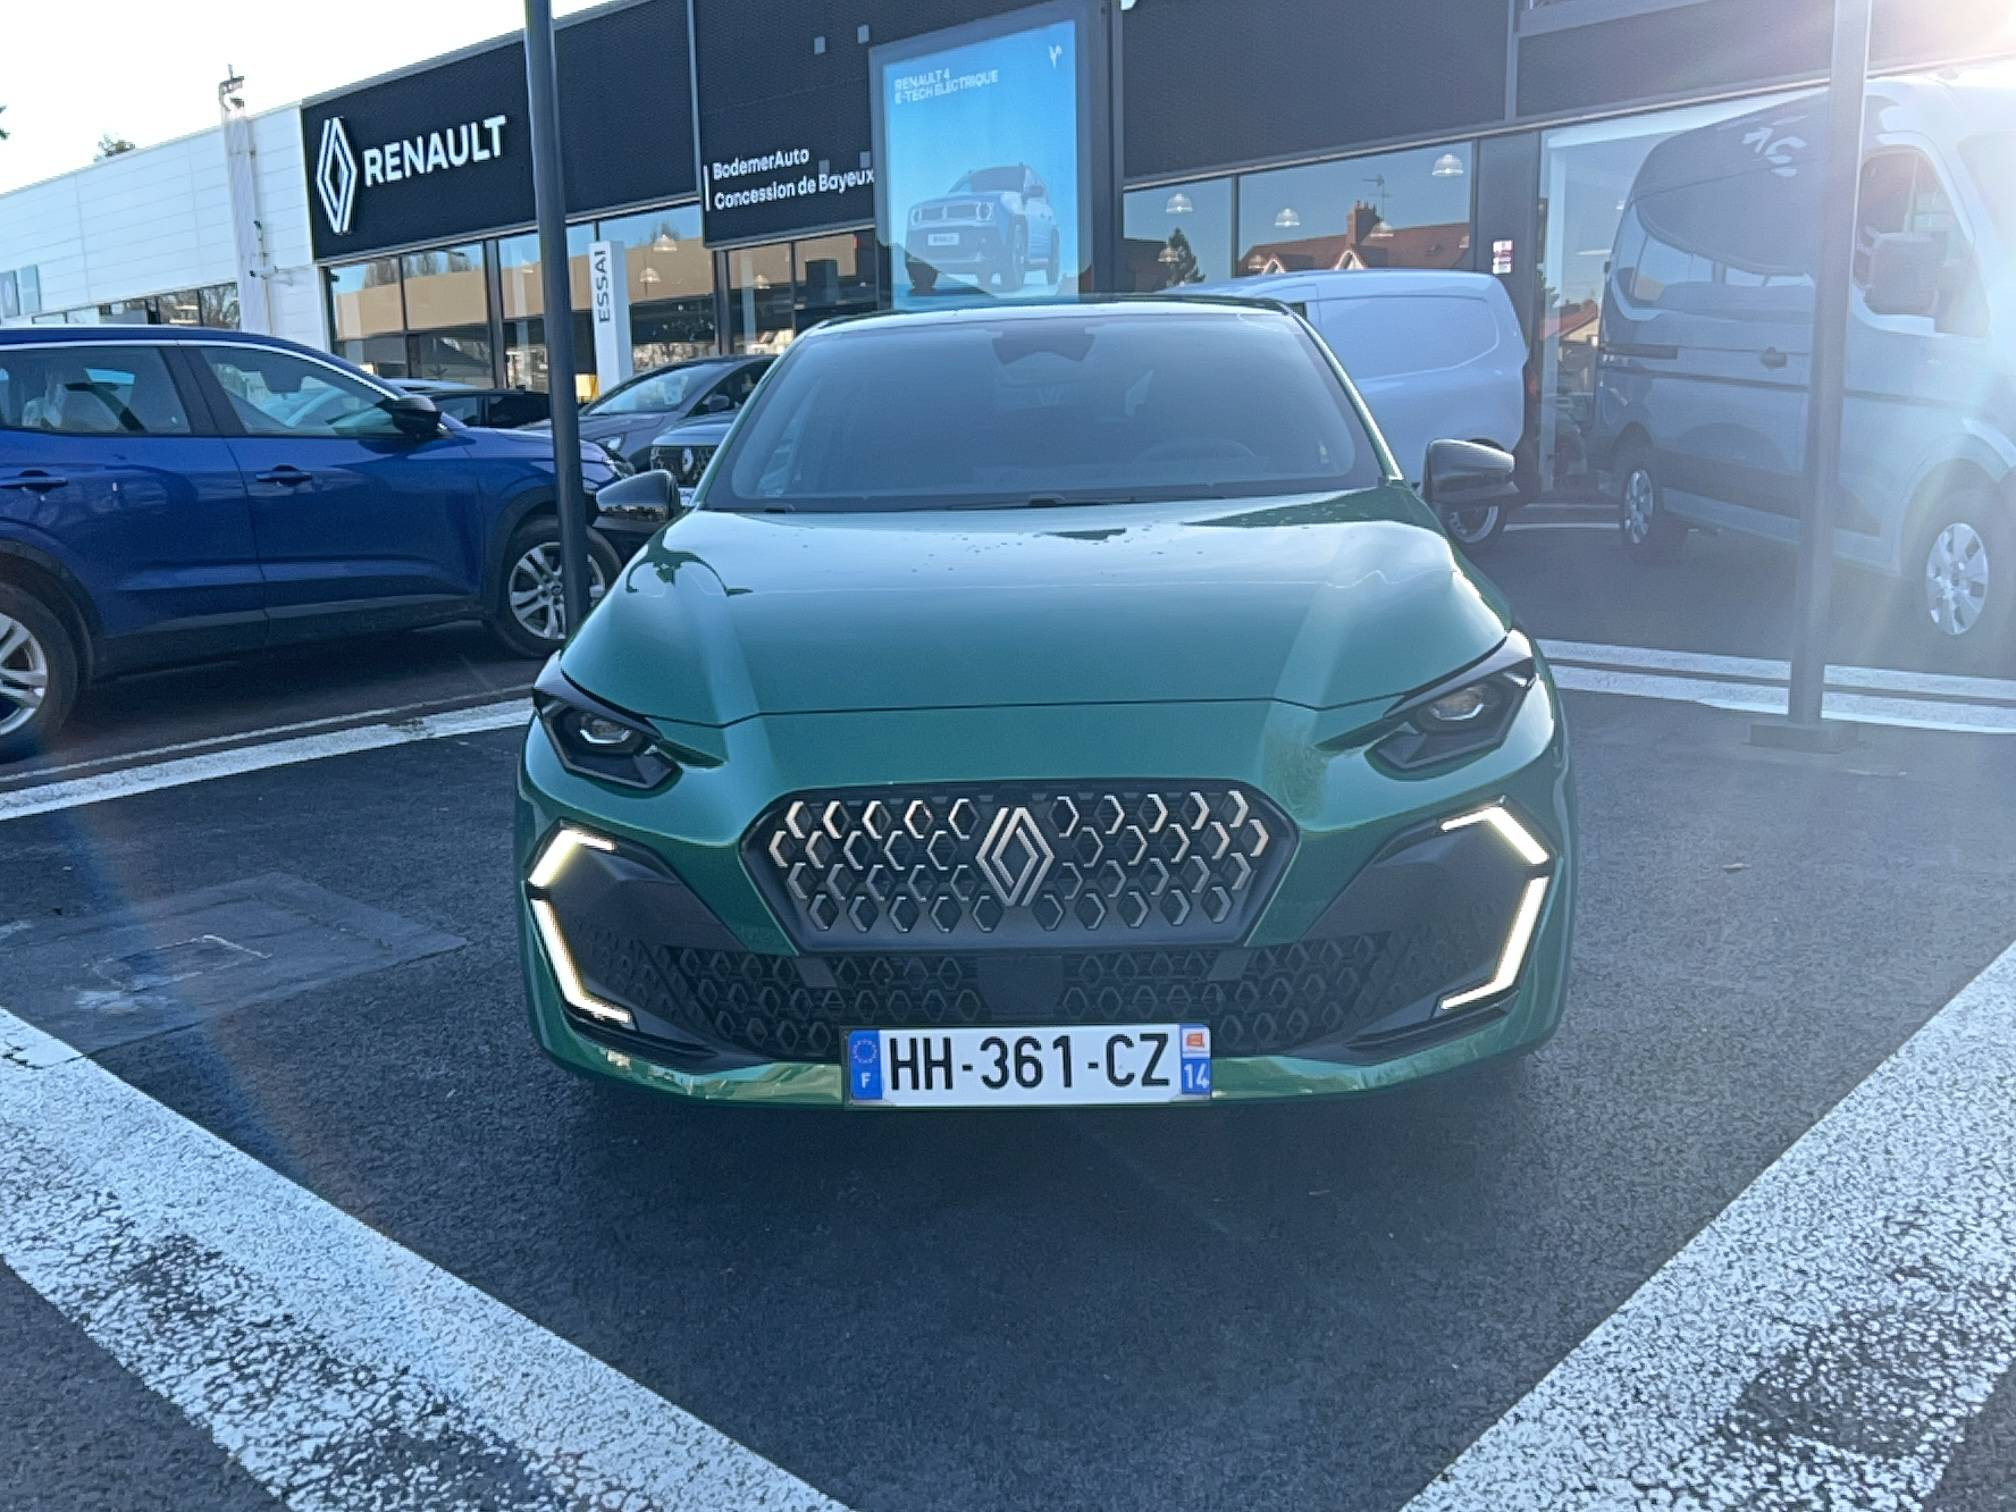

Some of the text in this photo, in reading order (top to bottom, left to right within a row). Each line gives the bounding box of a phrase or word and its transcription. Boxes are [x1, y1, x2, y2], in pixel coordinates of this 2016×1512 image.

[895, 70, 943, 92] RENAULT
[895, 85, 933, 104] E-TECH
[363, 114, 506, 188] RENAULT
[712, 148, 810, 180] BodemerAuto
[714, 168, 875, 210] Concession de Bayeux
[594, 250, 611, 322] ESSAI
[889, 1033, 1170, 1091] HH-361-CZ
[1183, 1062, 1209, 1089] 14
[861, 1072, 872, 1089] F
